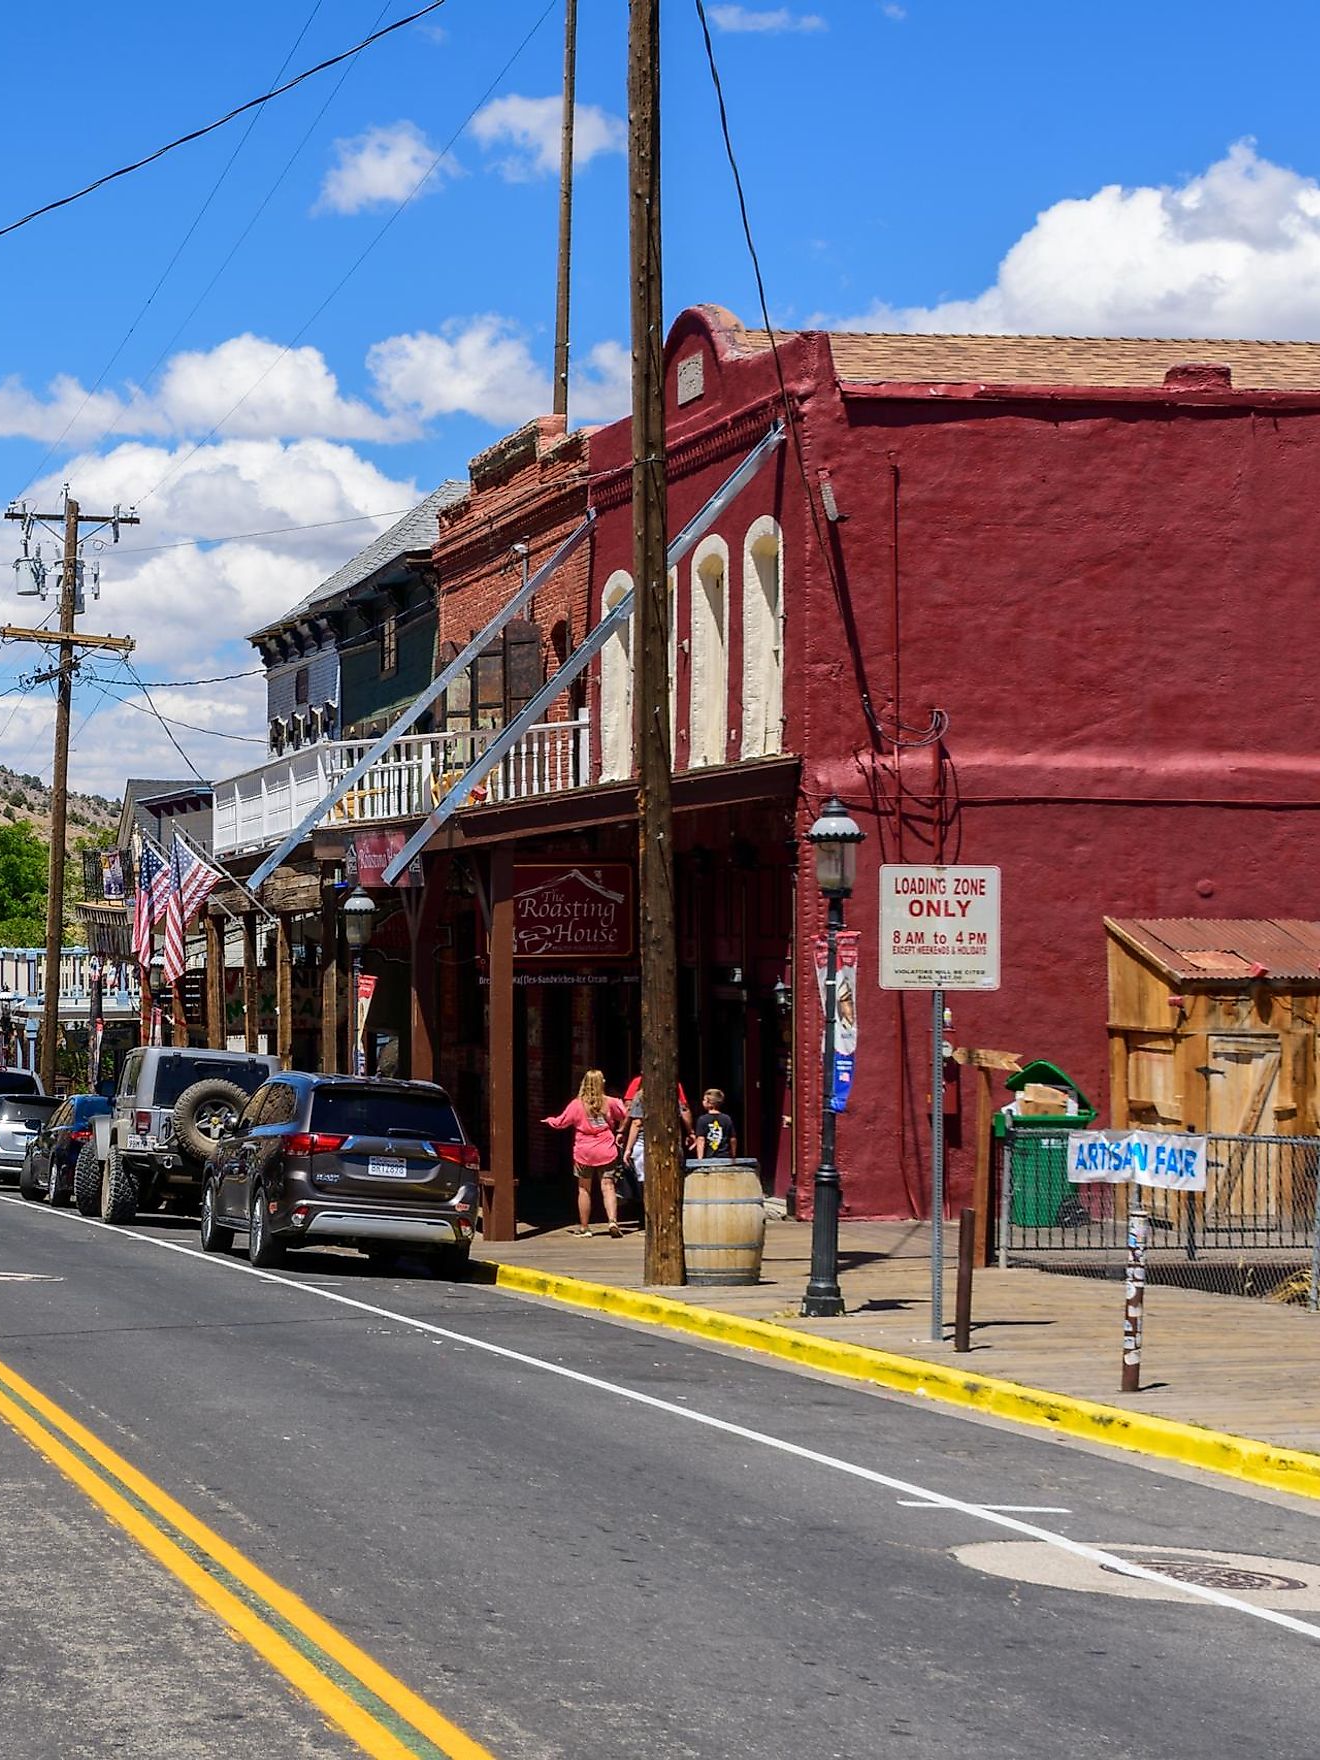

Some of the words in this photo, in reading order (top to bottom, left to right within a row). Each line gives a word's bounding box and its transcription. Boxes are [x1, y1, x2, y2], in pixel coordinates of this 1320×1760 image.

[543, 888, 565, 902] The
[894, 877, 946, 895] LOADING
[953, 878, 986, 896] ZONE
[518, 897, 616, 928] Roasting
[909, 899, 972, 917] ONLY
[552, 917, 618, 943] House
[893, 930, 901, 945] 8
[905, 931, 925, 945] AM
[933, 931, 947, 945] to
[955, 931, 964, 945] 4
[968, 932, 987, 945] PM
[892, 945, 916, 955] EXCEPT
[957, 946, 987, 956] HOLIDAYS
[1075, 1141, 1149, 1171] ARTISAN
[1154, 1145, 1199, 1178] FAIR
